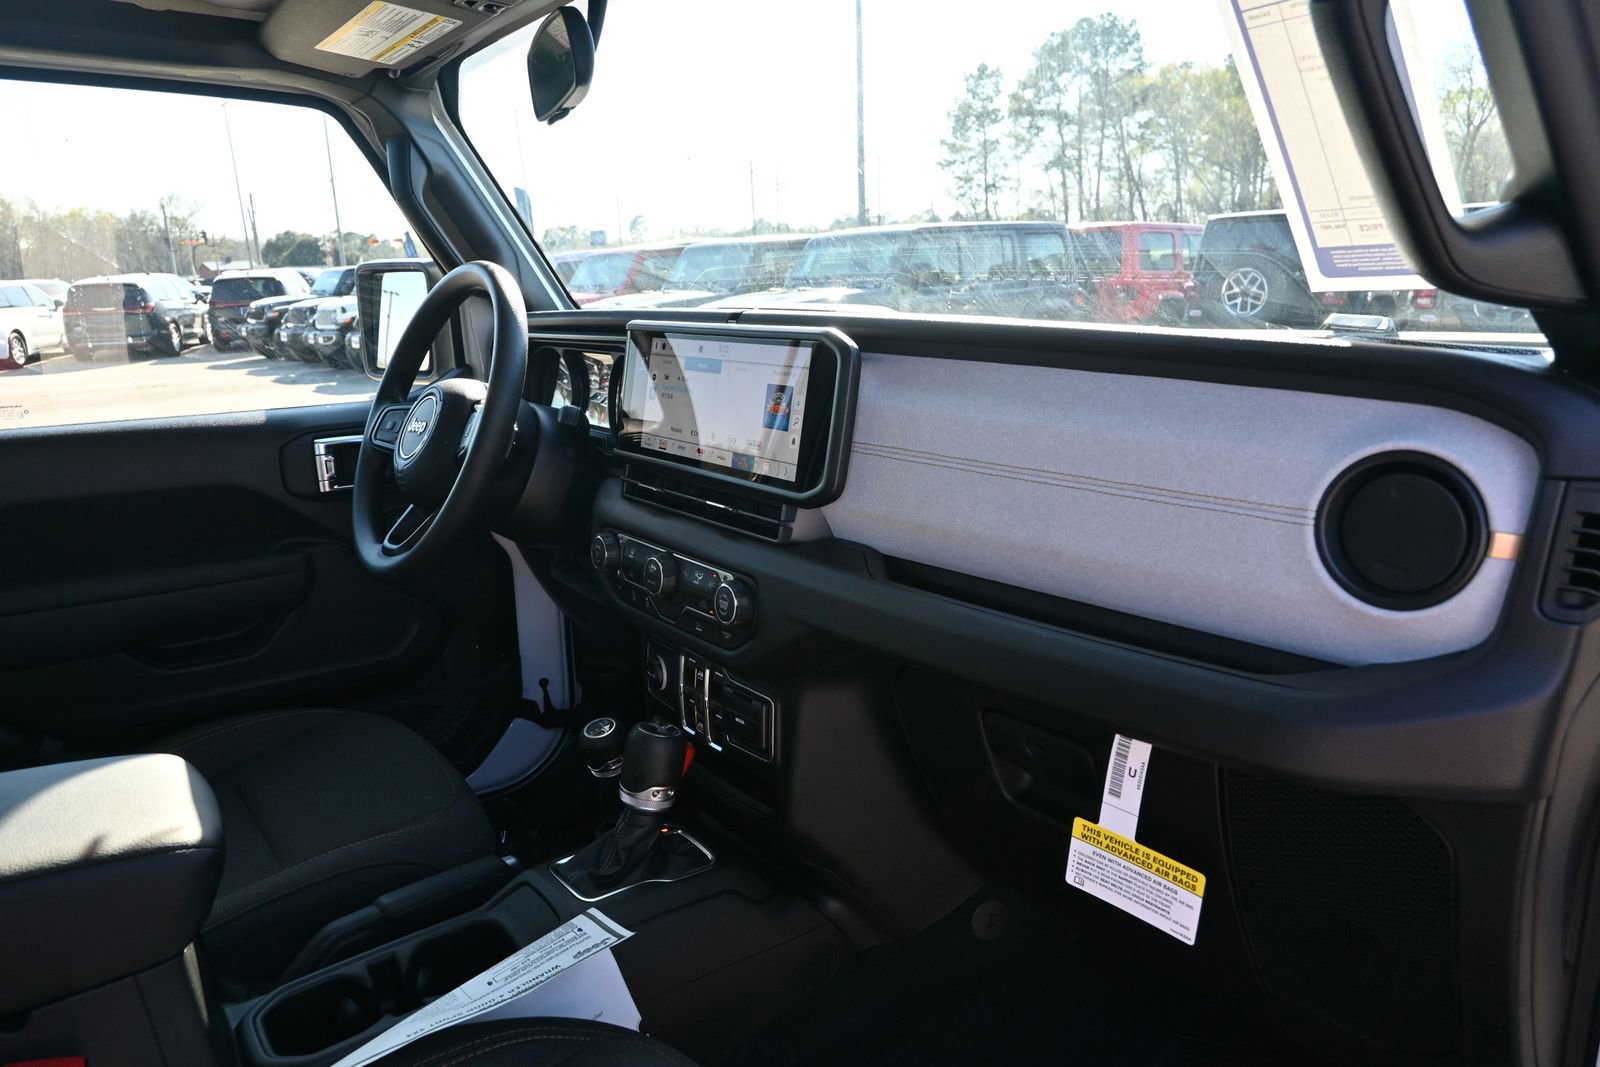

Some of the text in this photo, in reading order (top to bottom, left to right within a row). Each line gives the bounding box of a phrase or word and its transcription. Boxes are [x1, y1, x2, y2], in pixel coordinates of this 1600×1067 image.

[408, 417, 427, 435] Jeep
[1080, 830, 1196, 891] WITH ADVANCED AIR BAGS
[1081, 823, 1198, 884] THIS VEHICLE IS EQUIPPED
[1092, 849, 1177, 895] EVEN WITH ADVANCED AIR BAGS
[573, 937, 612, 959] Jeep
